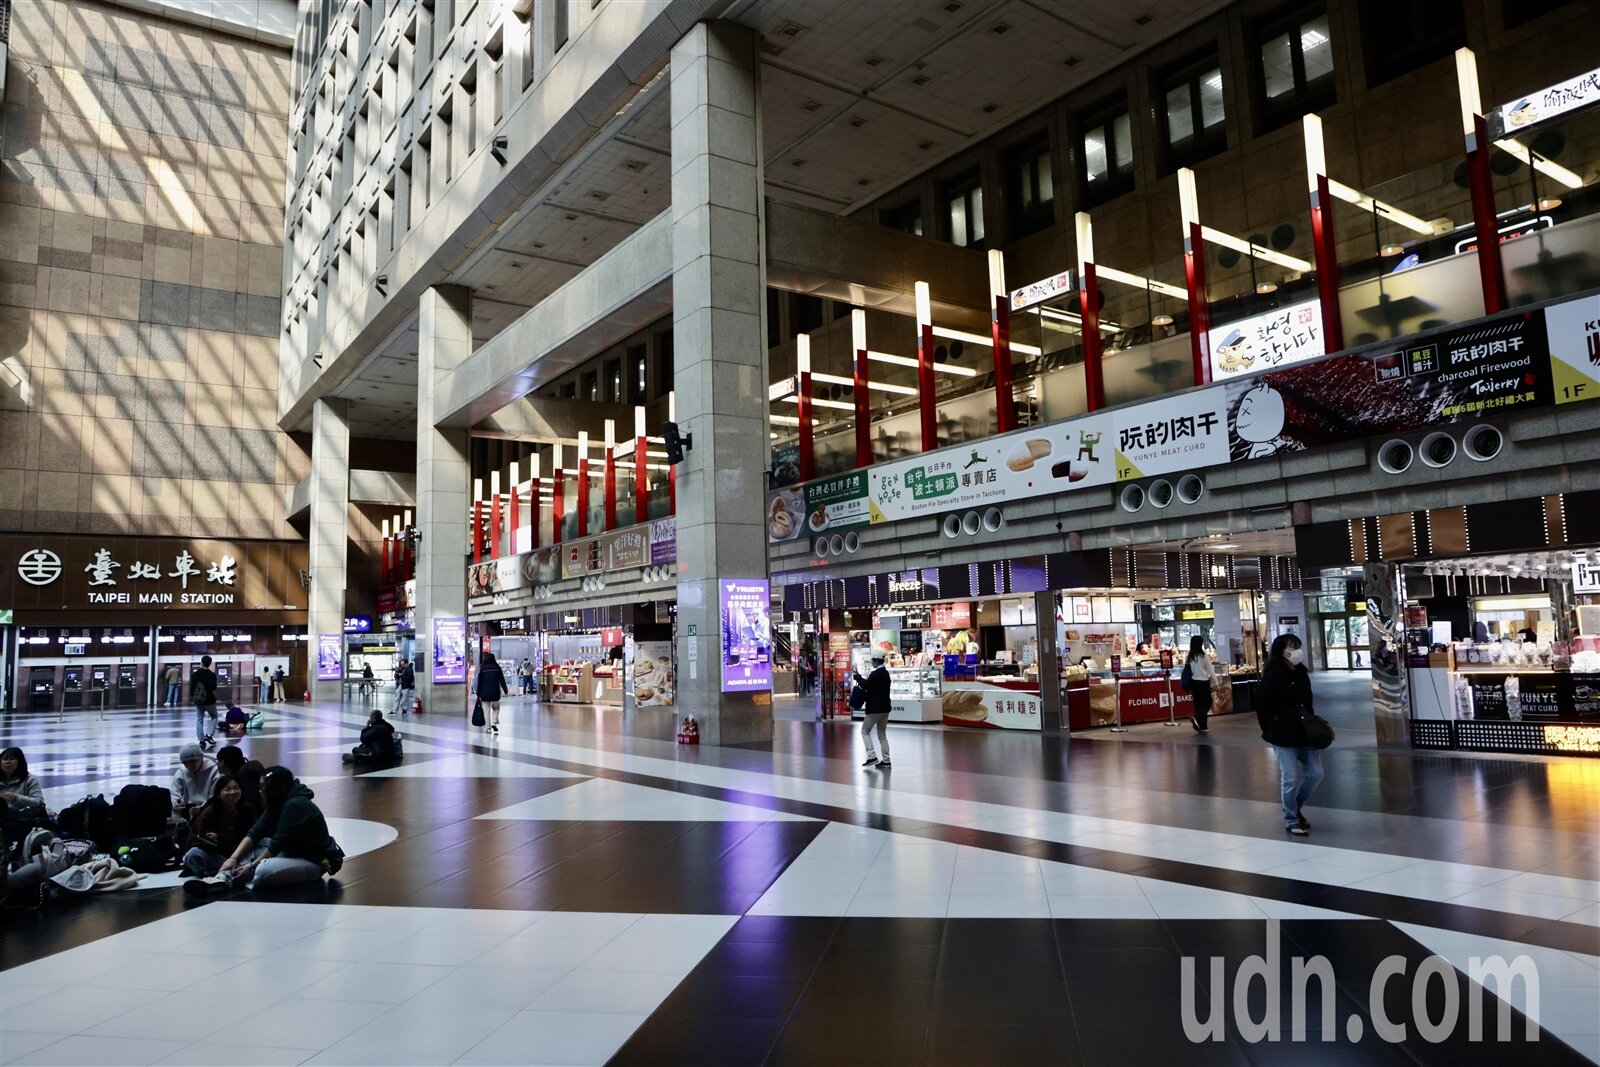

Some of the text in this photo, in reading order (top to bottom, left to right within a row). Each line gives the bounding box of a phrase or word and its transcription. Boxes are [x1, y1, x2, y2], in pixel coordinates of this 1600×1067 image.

[1412, 349, 1431, 362] 黑豆
[1451, 336, 1524, 364] 阮的肉干
[1438, 356, 1531, 383] charcoal Firewood
[1563, 384, 1586, 398] 1F
[1120, 411, 1218, 452] 阮的肉干
[1134, 443, 1205, 461] YUNYE MEAT CURD
[907, 470, 923, 483] 台中
[1119, 468, 1131, 478] 1F
[914, 468, 997, 496] 波士頓派 專賣店
[911, 503, 927, 511] Boston
[937, 496, 960, 506] Specialty
[961, 493, 974, 502] Store
[982, 488, 1006, 498] Taichung
[871, 514, 880, 522] 1F
[85, 548, 237, 589] 臺北車站
[889, 581, 921, 592] Breeze
[88, 593, 234, 603] TAIPEI MAIN STATION
[996, 700, 1036, 714] 福利麵包
[1128, 697, 1158, 707] FLORIDA
